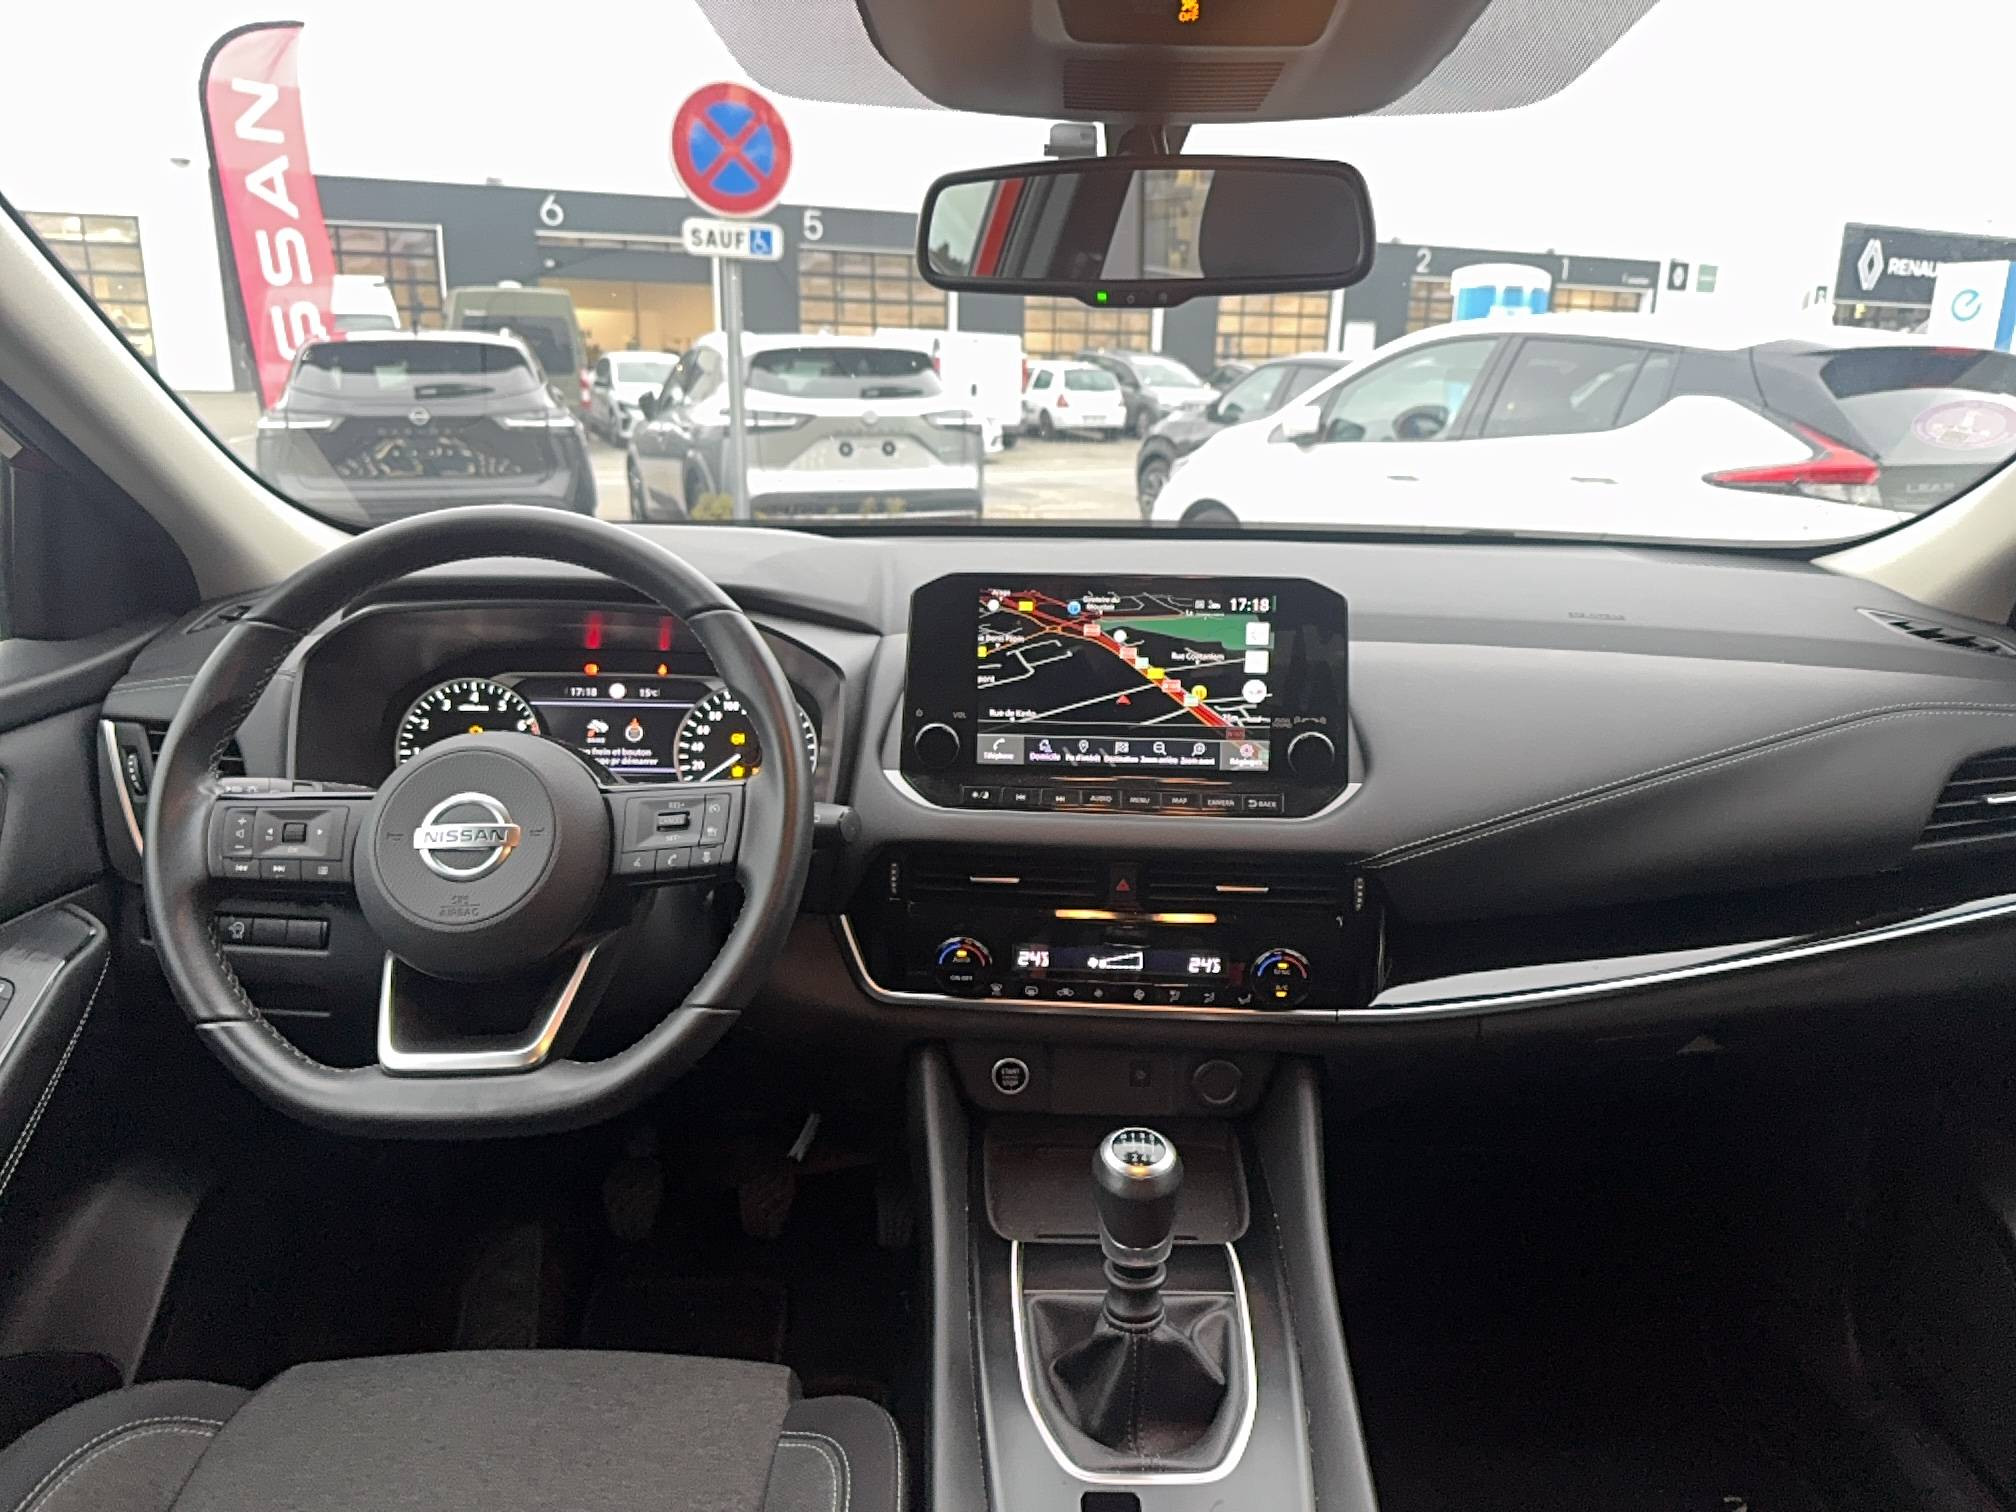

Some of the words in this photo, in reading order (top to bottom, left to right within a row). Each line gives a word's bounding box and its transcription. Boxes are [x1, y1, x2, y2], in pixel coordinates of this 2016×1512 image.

[540, 192, 564, 227] 6
[803, 209, 823, 240] 5
[691, 227, 745, 249] SAUF
[1416, 247, 1432, 273] 2
[1561, 258, 1570, 281] 1
[470, 692, 480, 703] 4
[570, 687, 597, 697] 17:18
[442, 699, 452, 711] 3
[497, 700, 508, 711] 5
[420, 718, 430, 730] 2
[516, 719, 528, 731] 6
[692, 760, 706, 770] 20
[423, 829, 509, 844] NISSAN
